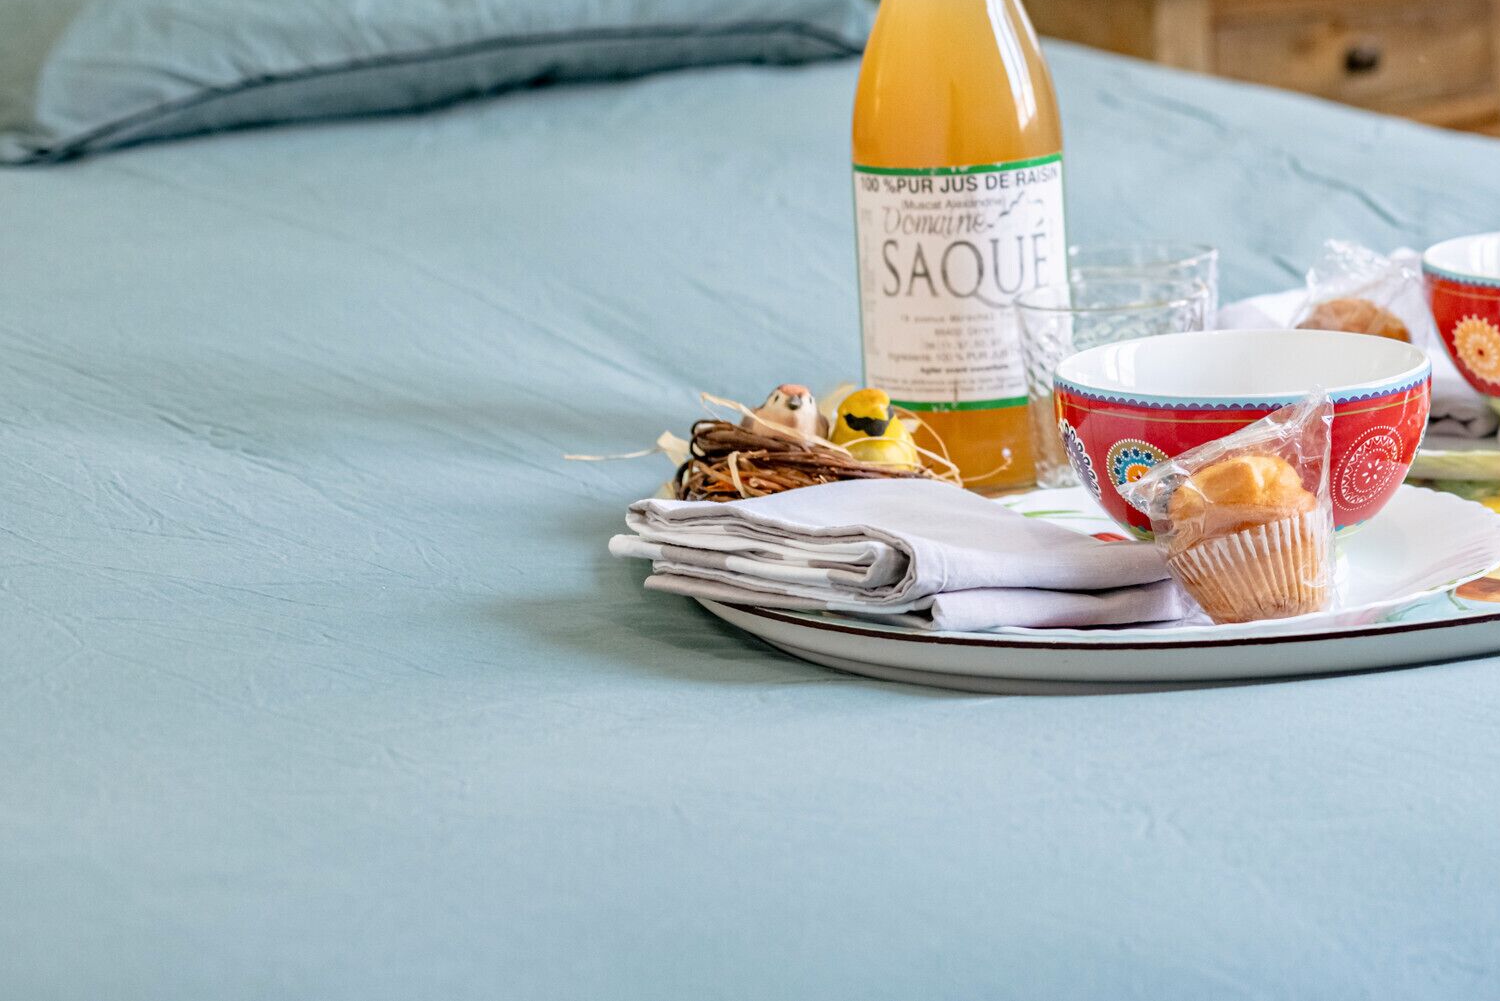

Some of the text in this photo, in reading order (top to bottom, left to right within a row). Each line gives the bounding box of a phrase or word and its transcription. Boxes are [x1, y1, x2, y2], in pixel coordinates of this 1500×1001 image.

[860, 176, 879, 193] 100
[939, 176, 979, 194] JUS
[985, 175, 1010, 190] DE
[1015, 169, 1059, 188] RAISIN
